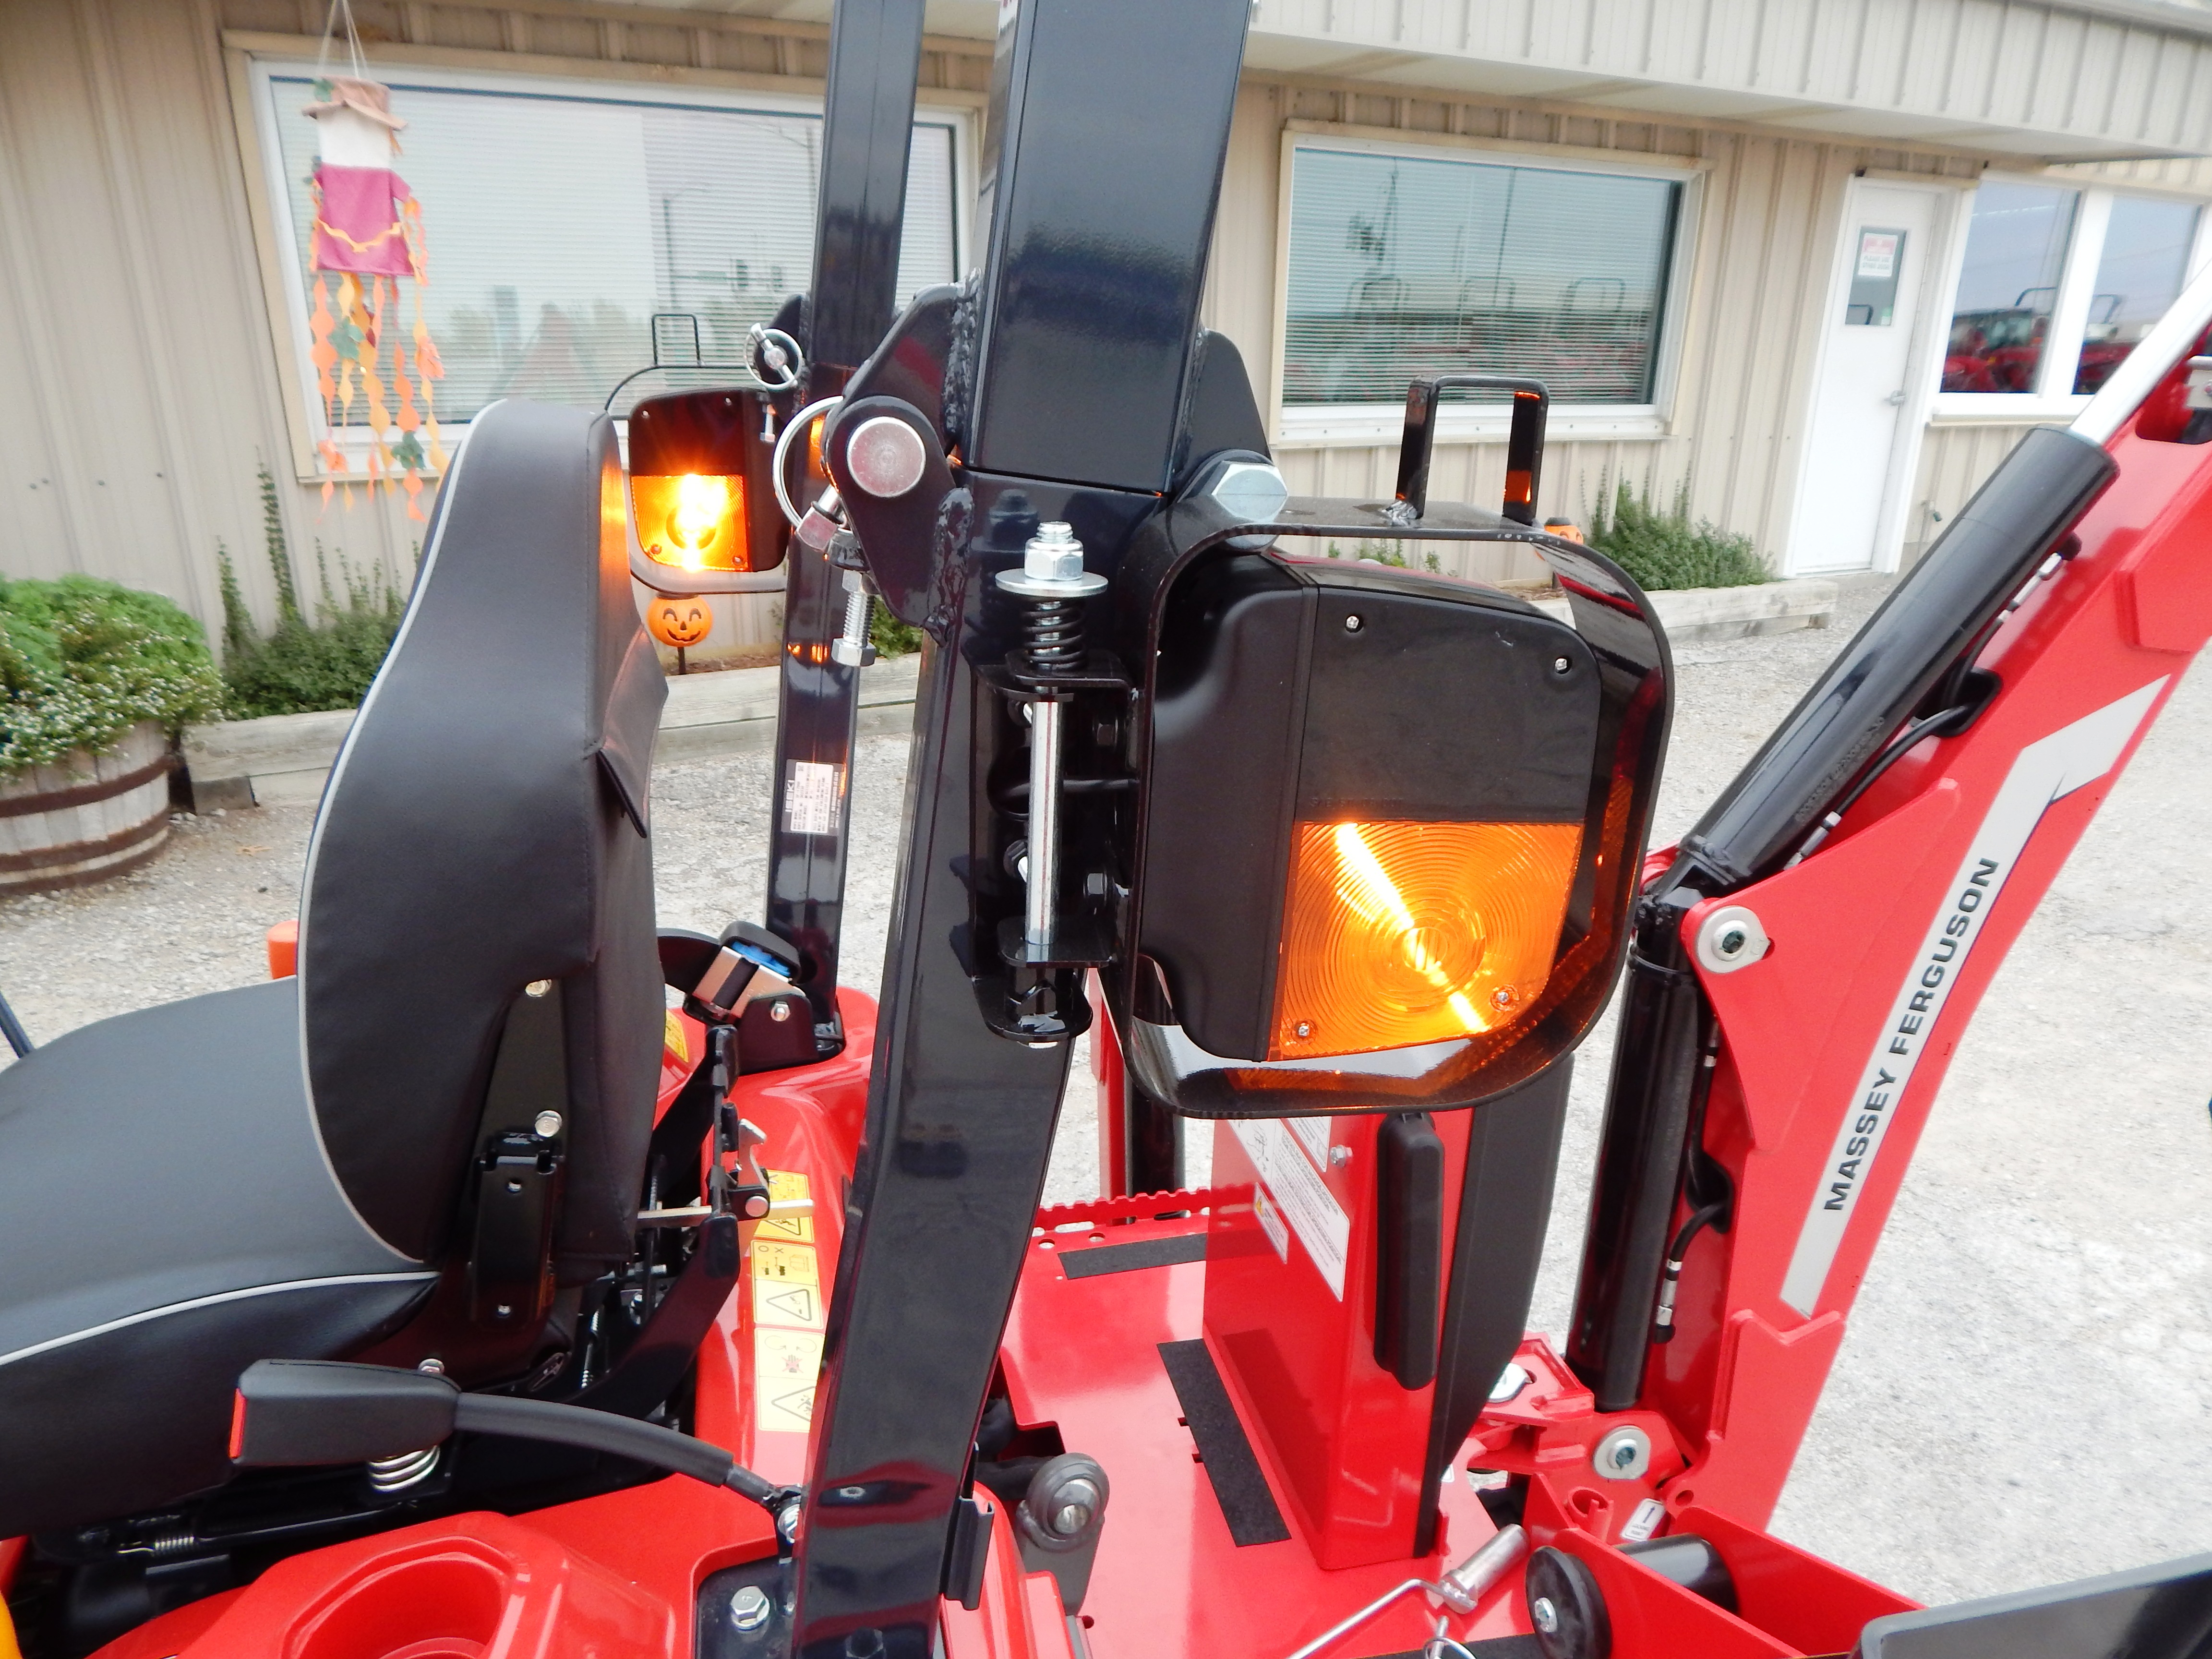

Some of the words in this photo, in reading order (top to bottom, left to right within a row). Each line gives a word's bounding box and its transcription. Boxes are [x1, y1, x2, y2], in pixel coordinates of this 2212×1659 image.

[785, 779, 795, 812] ISEKI
[1824, 1067, 1898, 1211] MASSEY
[1888, 857, 1999, 1056] FERGUSON
